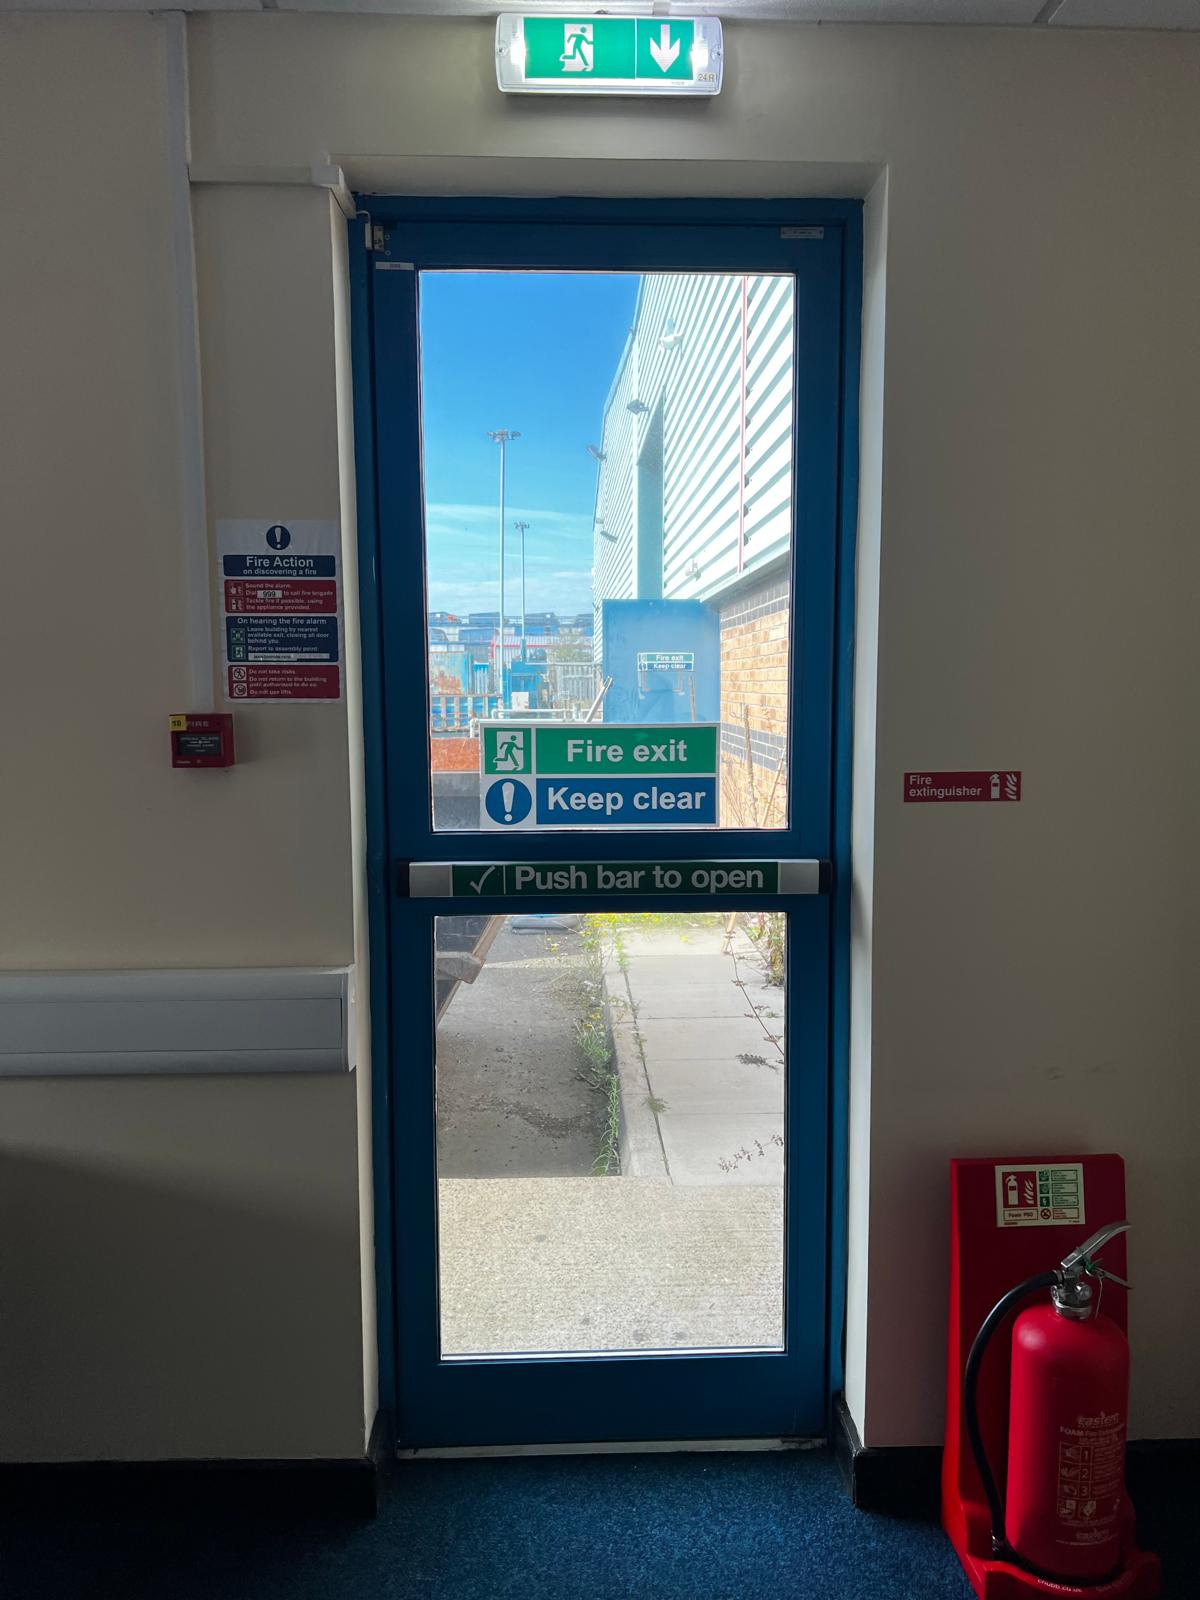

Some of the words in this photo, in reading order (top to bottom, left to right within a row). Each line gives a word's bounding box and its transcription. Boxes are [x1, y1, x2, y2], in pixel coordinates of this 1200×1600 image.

[246, 556, 270, 567] Fire
[273, 556, 314, 567] Action
[254, 568, 297, 576] discovering
[249, 618, 277, 626] hearing
[567, 739, 624, 762] Fire
[633, 739, 687, 762] exit
[909, 775, 932, 785] Fire
[909, 786, 982, 798] extinguisher
[548, 786, 624, 815] Keep
[633, 786, 706, 810] clear
[515, 864, 587, 890] Push
[597, 864, 645, 889] bar
[652, 864, 682, 889] to
[691, 867, 764, 893] open
[1059, 1426, 1084, 1436] FOAM
[1081, 1468, 1089, 1479] 2
[1081, 1486, 1088, 1496] 3
